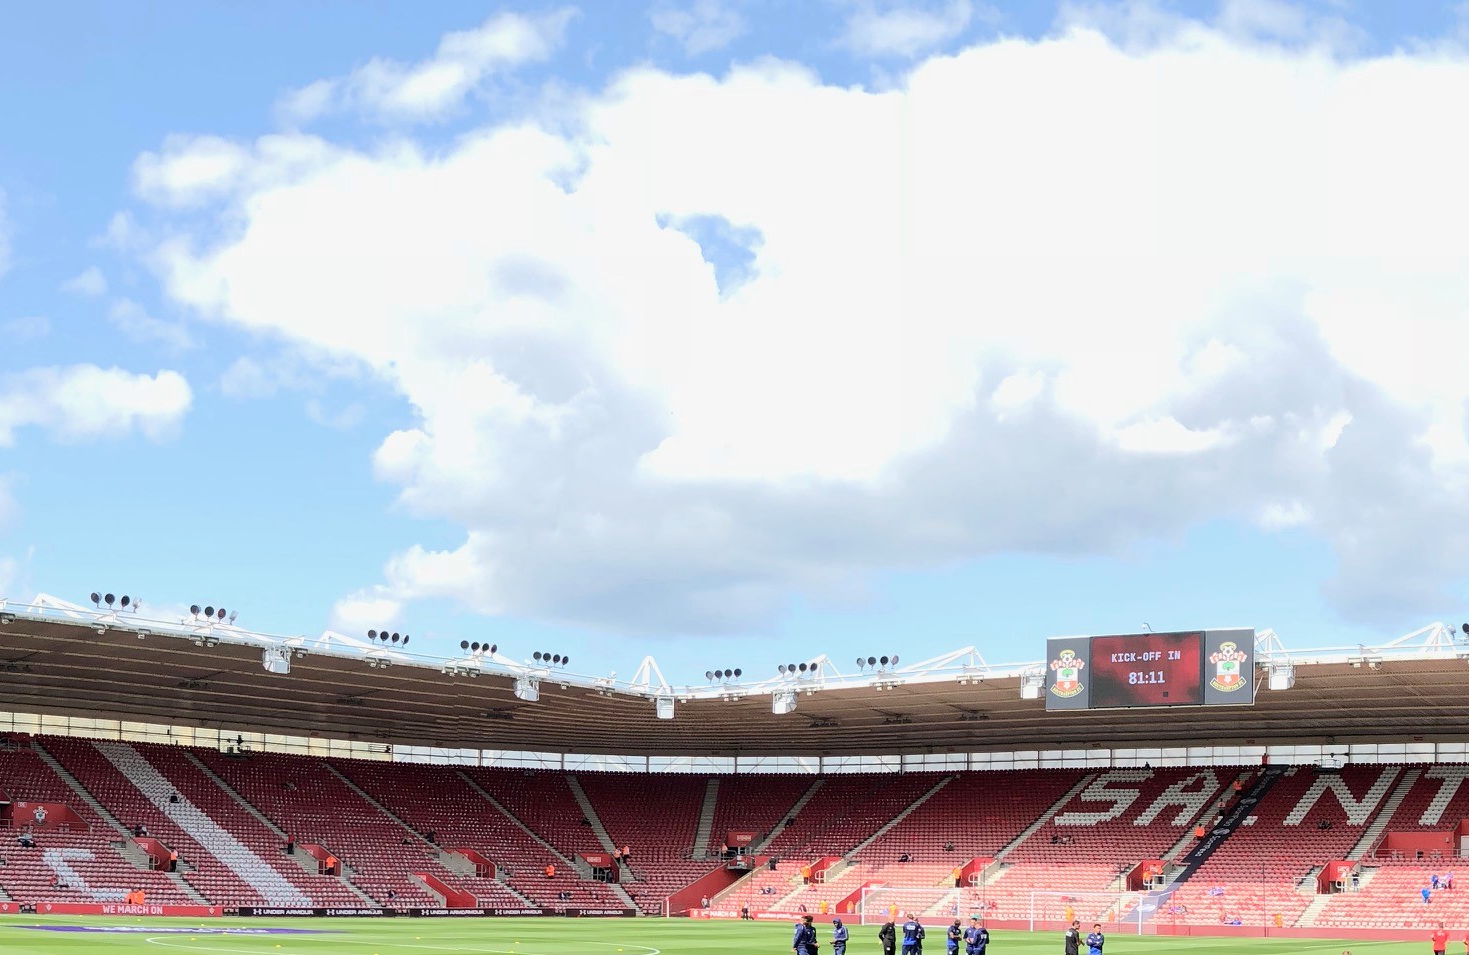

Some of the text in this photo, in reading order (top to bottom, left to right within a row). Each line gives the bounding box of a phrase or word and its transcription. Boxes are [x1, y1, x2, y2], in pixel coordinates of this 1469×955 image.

[1111, 650, 1181, 663] KICK-OFF IN
[1128, 671, 1165, 685] 81:11
[102, 905, 163, 915] WE MARCH ON
